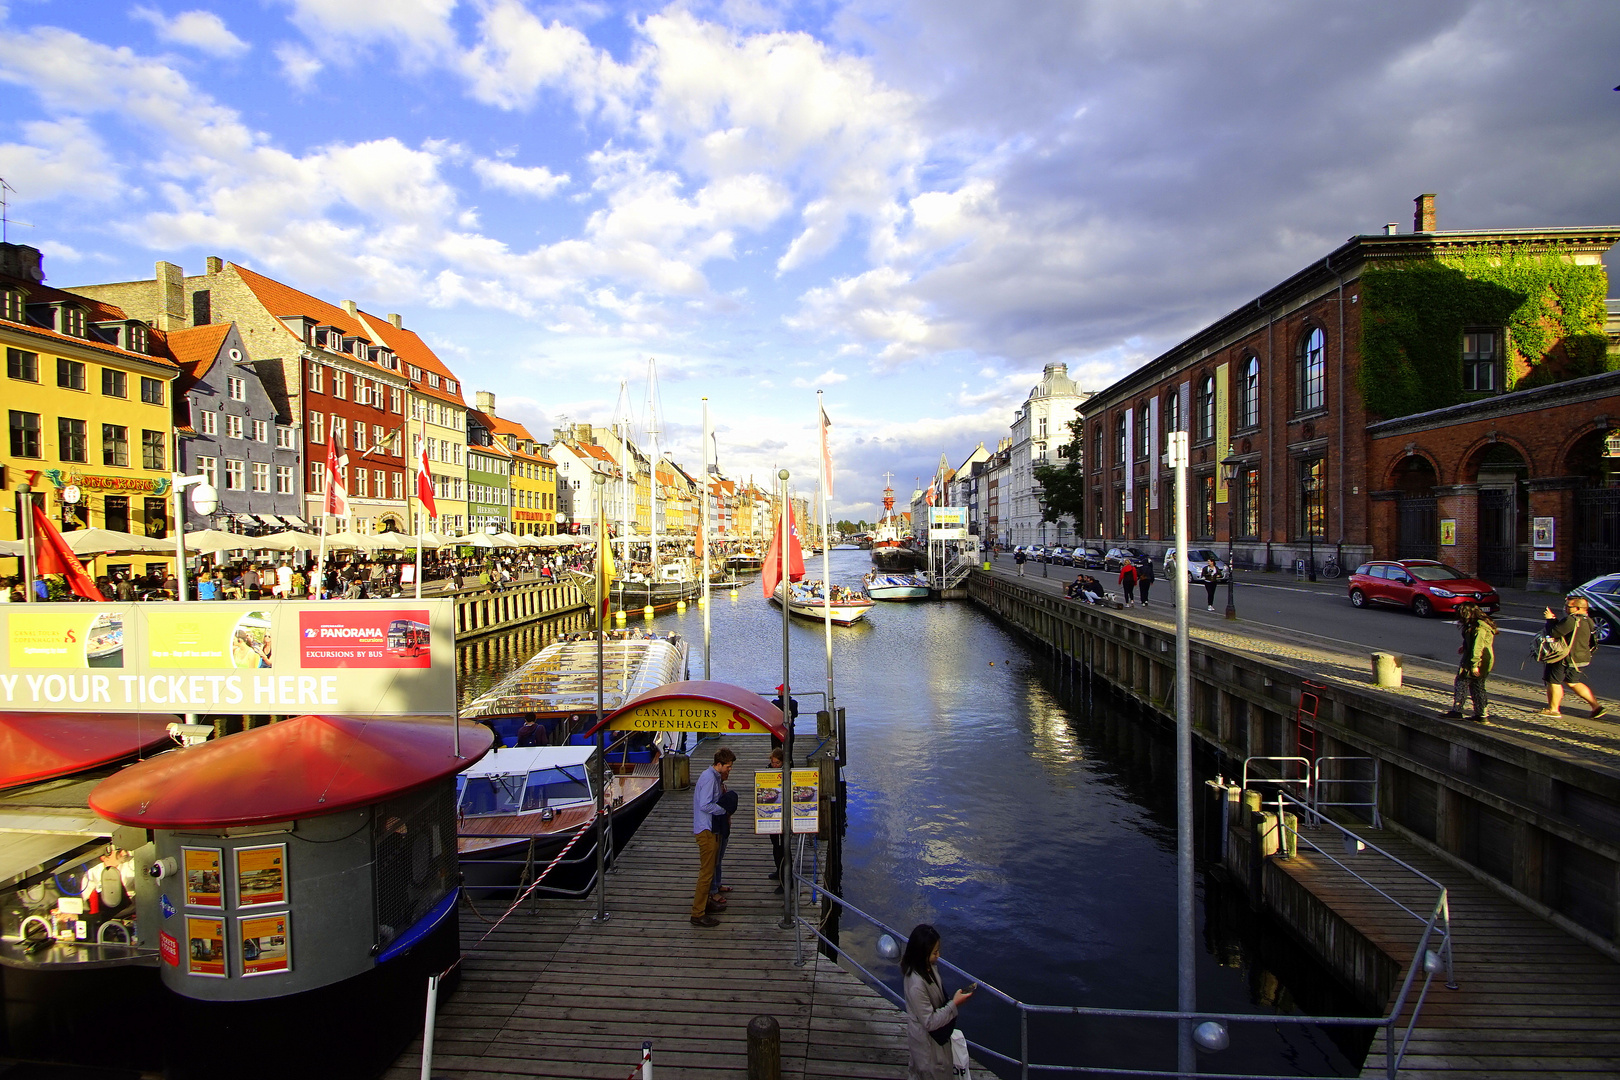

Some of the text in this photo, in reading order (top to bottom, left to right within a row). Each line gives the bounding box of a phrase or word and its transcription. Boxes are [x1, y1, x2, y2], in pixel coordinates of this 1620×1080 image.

[117, 477, 155, 490] KONG
[476, 505, 500, 515] HEERING
[320, 627, 383, 638] PANORAMA
[25, 674, 112, 703] YOUR
[118, 674, 243, 704] TICKETS
[253, 675, 338, 704] HERE
[634, 708, 717, 718] CANAL TOURS
[634, 719, 719, 729] COPENHAGEN
